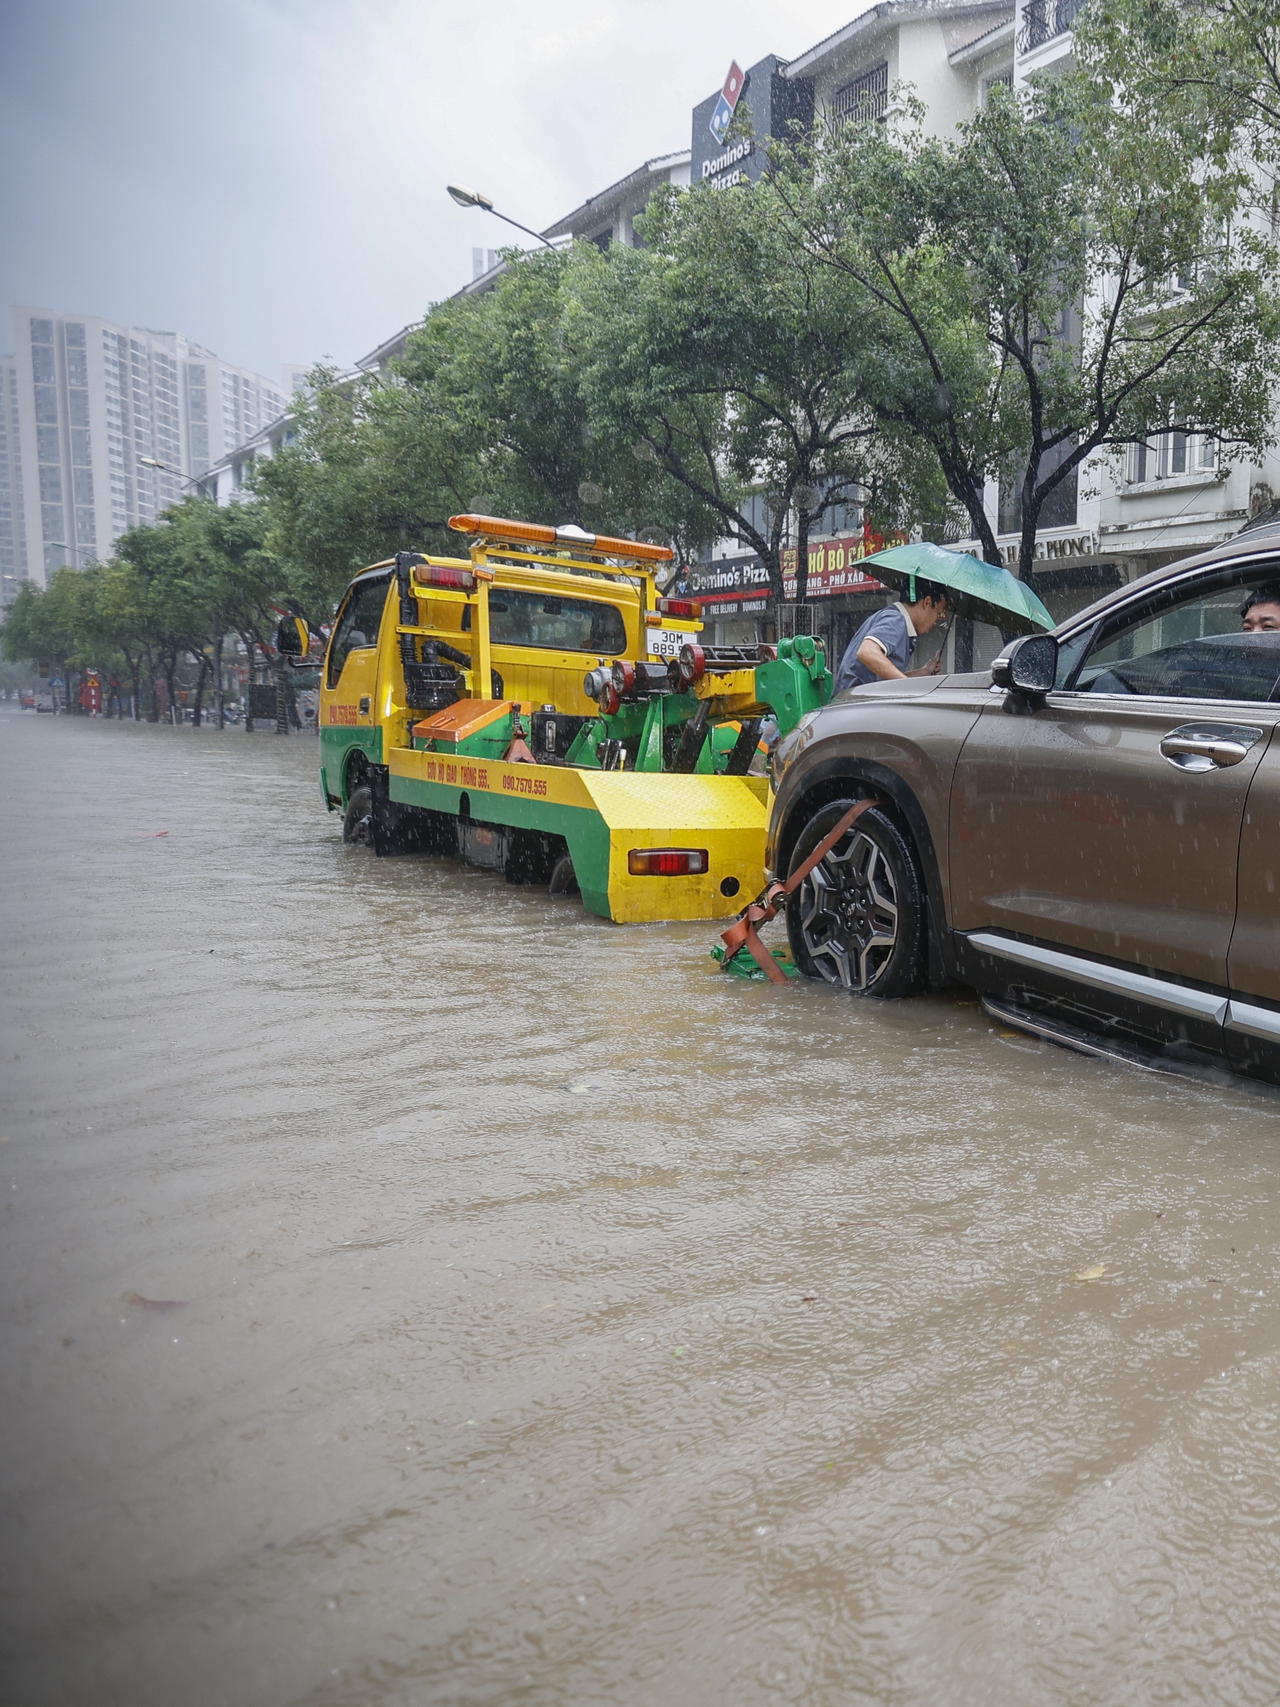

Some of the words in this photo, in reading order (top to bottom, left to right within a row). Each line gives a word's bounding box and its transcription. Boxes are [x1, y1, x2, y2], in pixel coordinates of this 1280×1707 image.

[702, 136, 751, 179] Domino's
[711, 169, 740, 190] Pizza
[1046, 535, 1092, 559] PHONG
[808, 544, 825, 574] HỞ
[828, 543, 845, 572] BÒ
[692, 565, 741, 591] Domino's
[806, 577, 822, 588] ANG
[829, 572, 846, 586] PHỞ
[710, 605, 720, 615] FREE
[720, 603, 738, 614] DELIVERY
[662, 632, 683, 644] 30M
[502, 775, 547, 796] 090.7579.555
